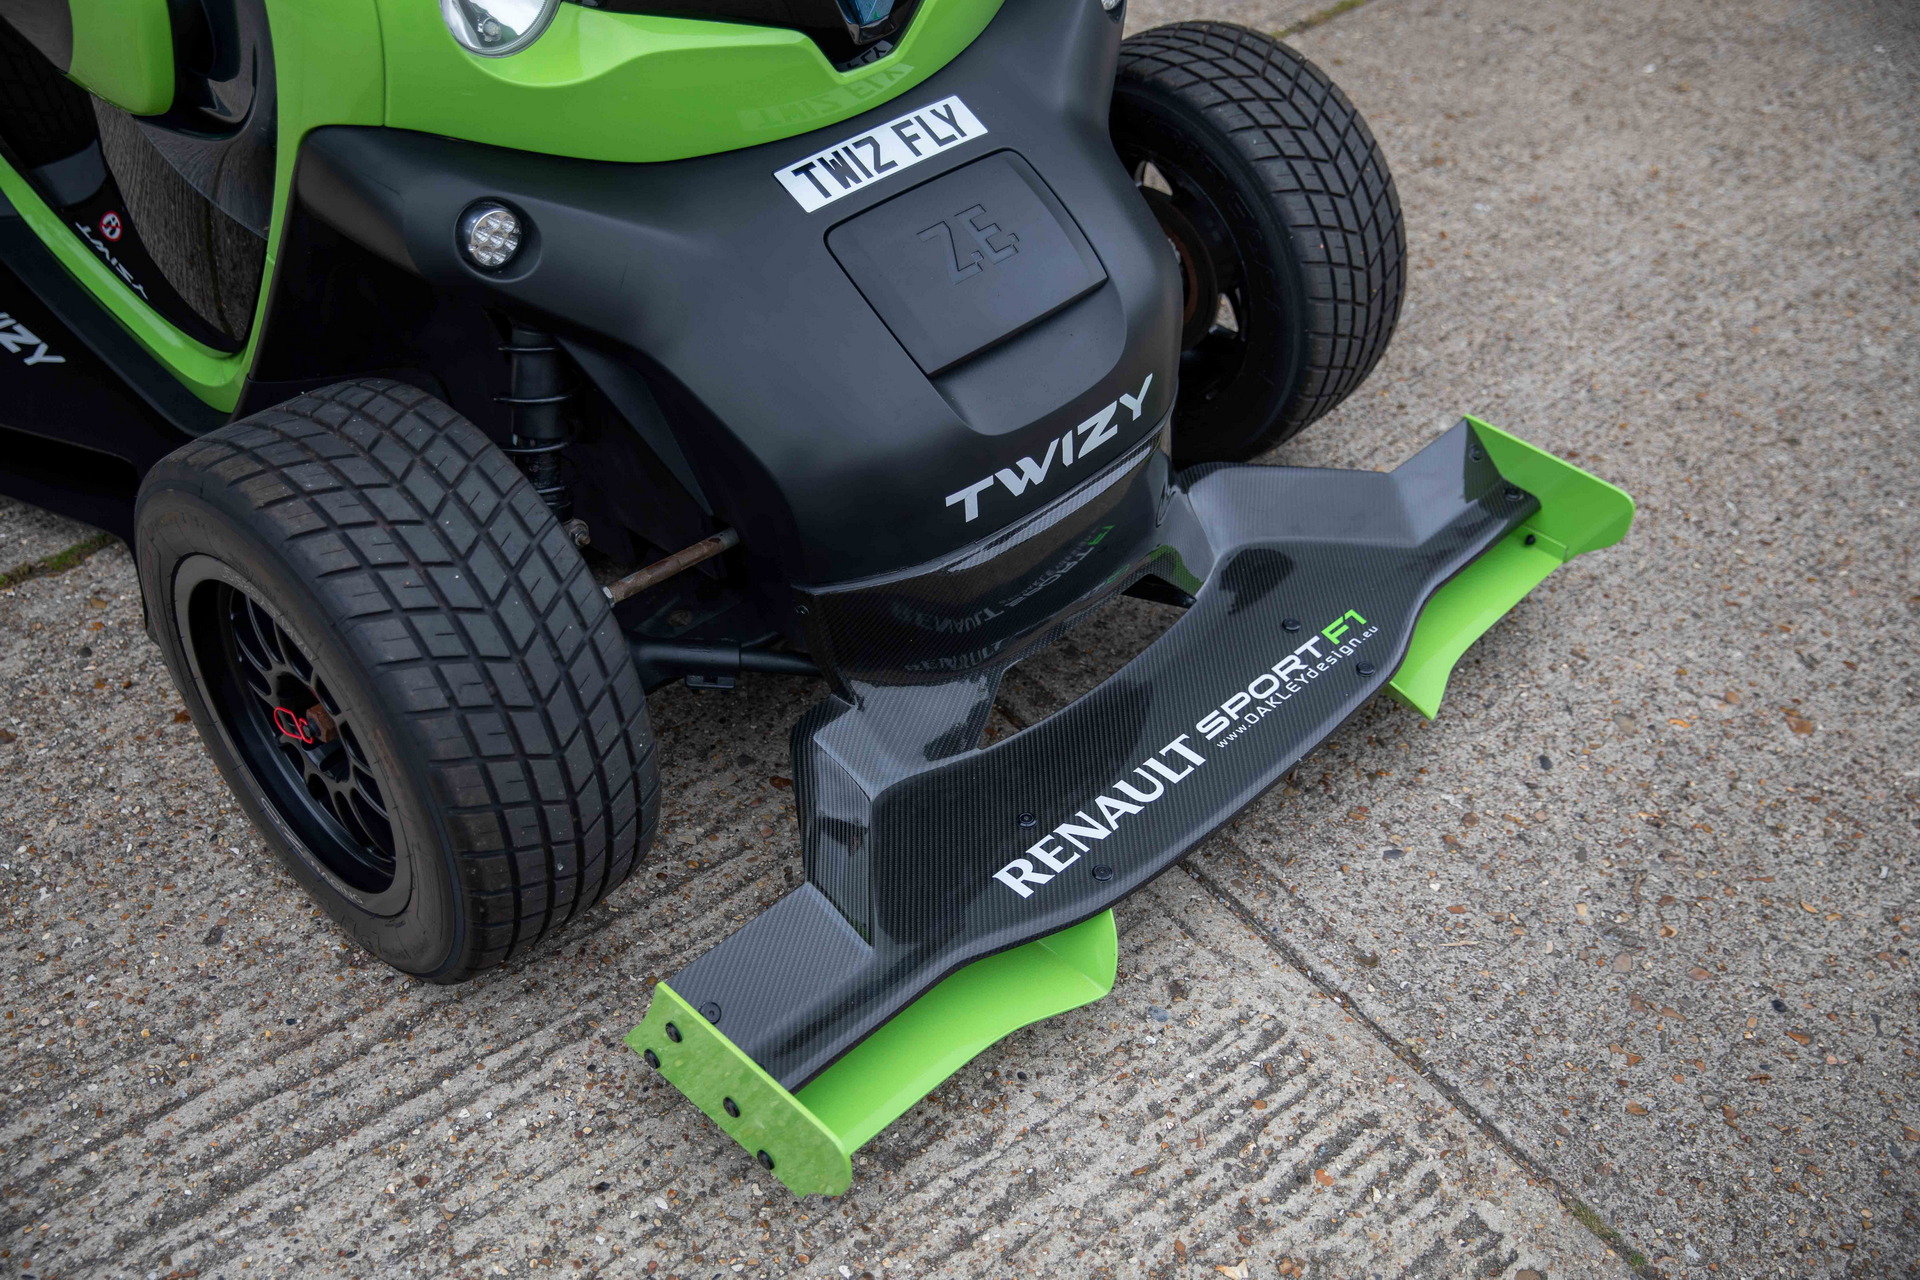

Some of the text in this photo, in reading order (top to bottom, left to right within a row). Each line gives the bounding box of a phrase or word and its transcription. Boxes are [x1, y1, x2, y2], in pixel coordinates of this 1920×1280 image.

[890, 103, 967, 158] FLY
[0, 312, 66, 366] IZY
[945, 373, 1153, 523] TWIZY
[1216, 625, 1379, 748] www.OAKLEYdesign.eu
[992, 609, 1367, 899] RENAULT SPORT F1
